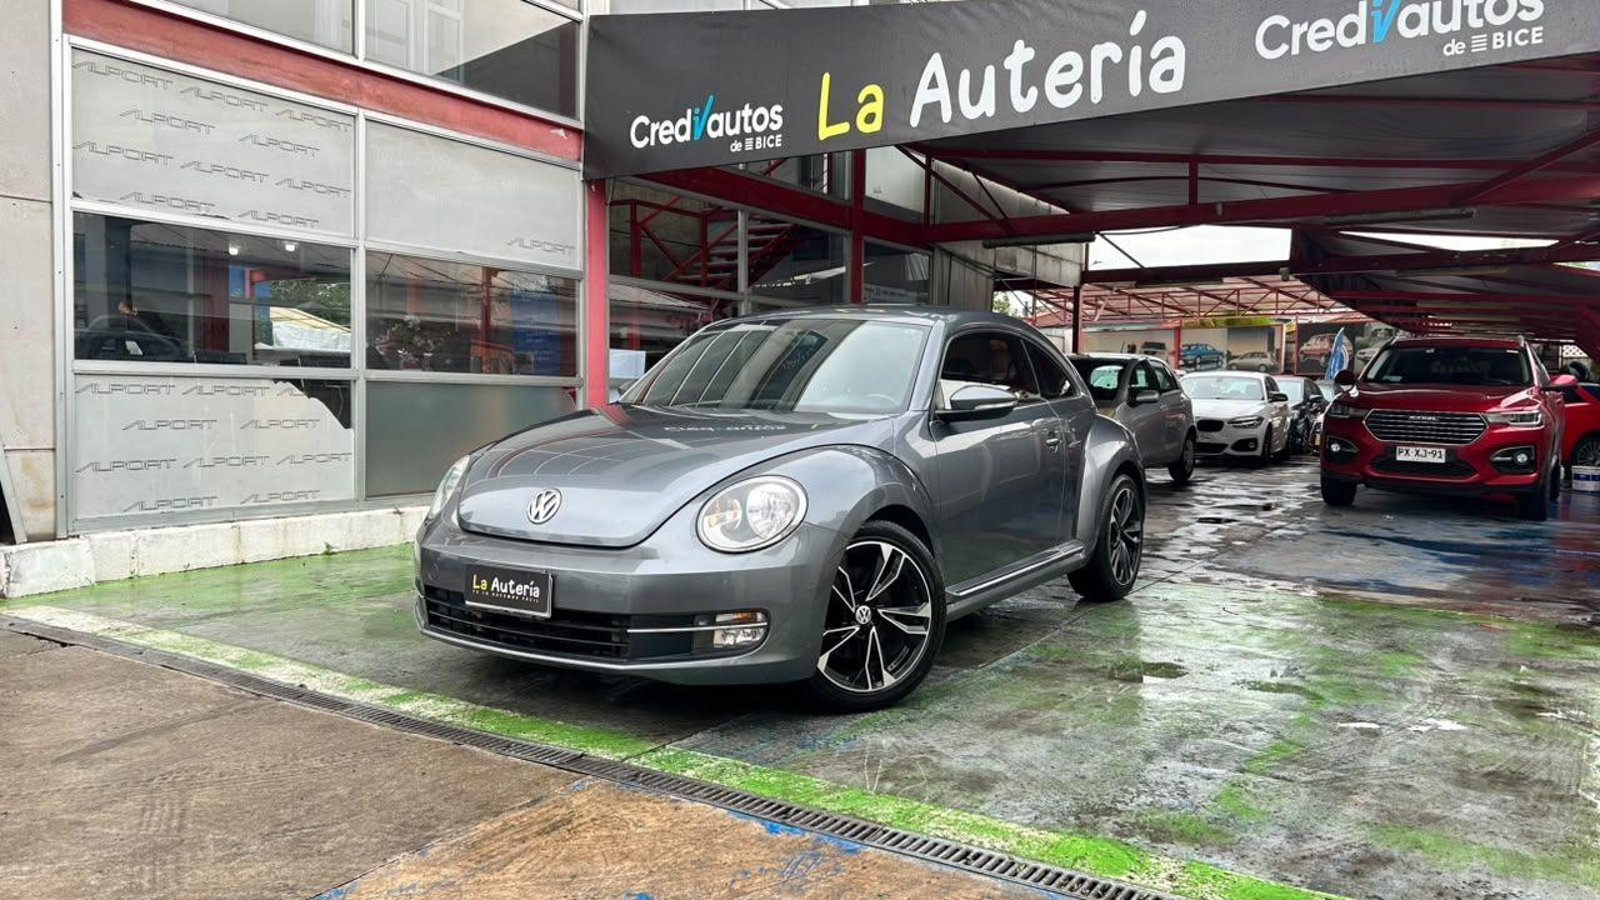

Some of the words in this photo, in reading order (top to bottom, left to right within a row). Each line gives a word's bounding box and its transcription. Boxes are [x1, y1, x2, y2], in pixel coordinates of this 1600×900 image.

[1443, 38, 1466, 56] de
[1492, 26, 1544, 49] BICE
[817, 72, 884, 141] La
[909, 9, 1187, 129] Autería
[730, 140, 742, 152] de
[755, 134, 782, 149] BICE
[472, 574, 487, 591] La
[491, 577, 540, 598] Autería
